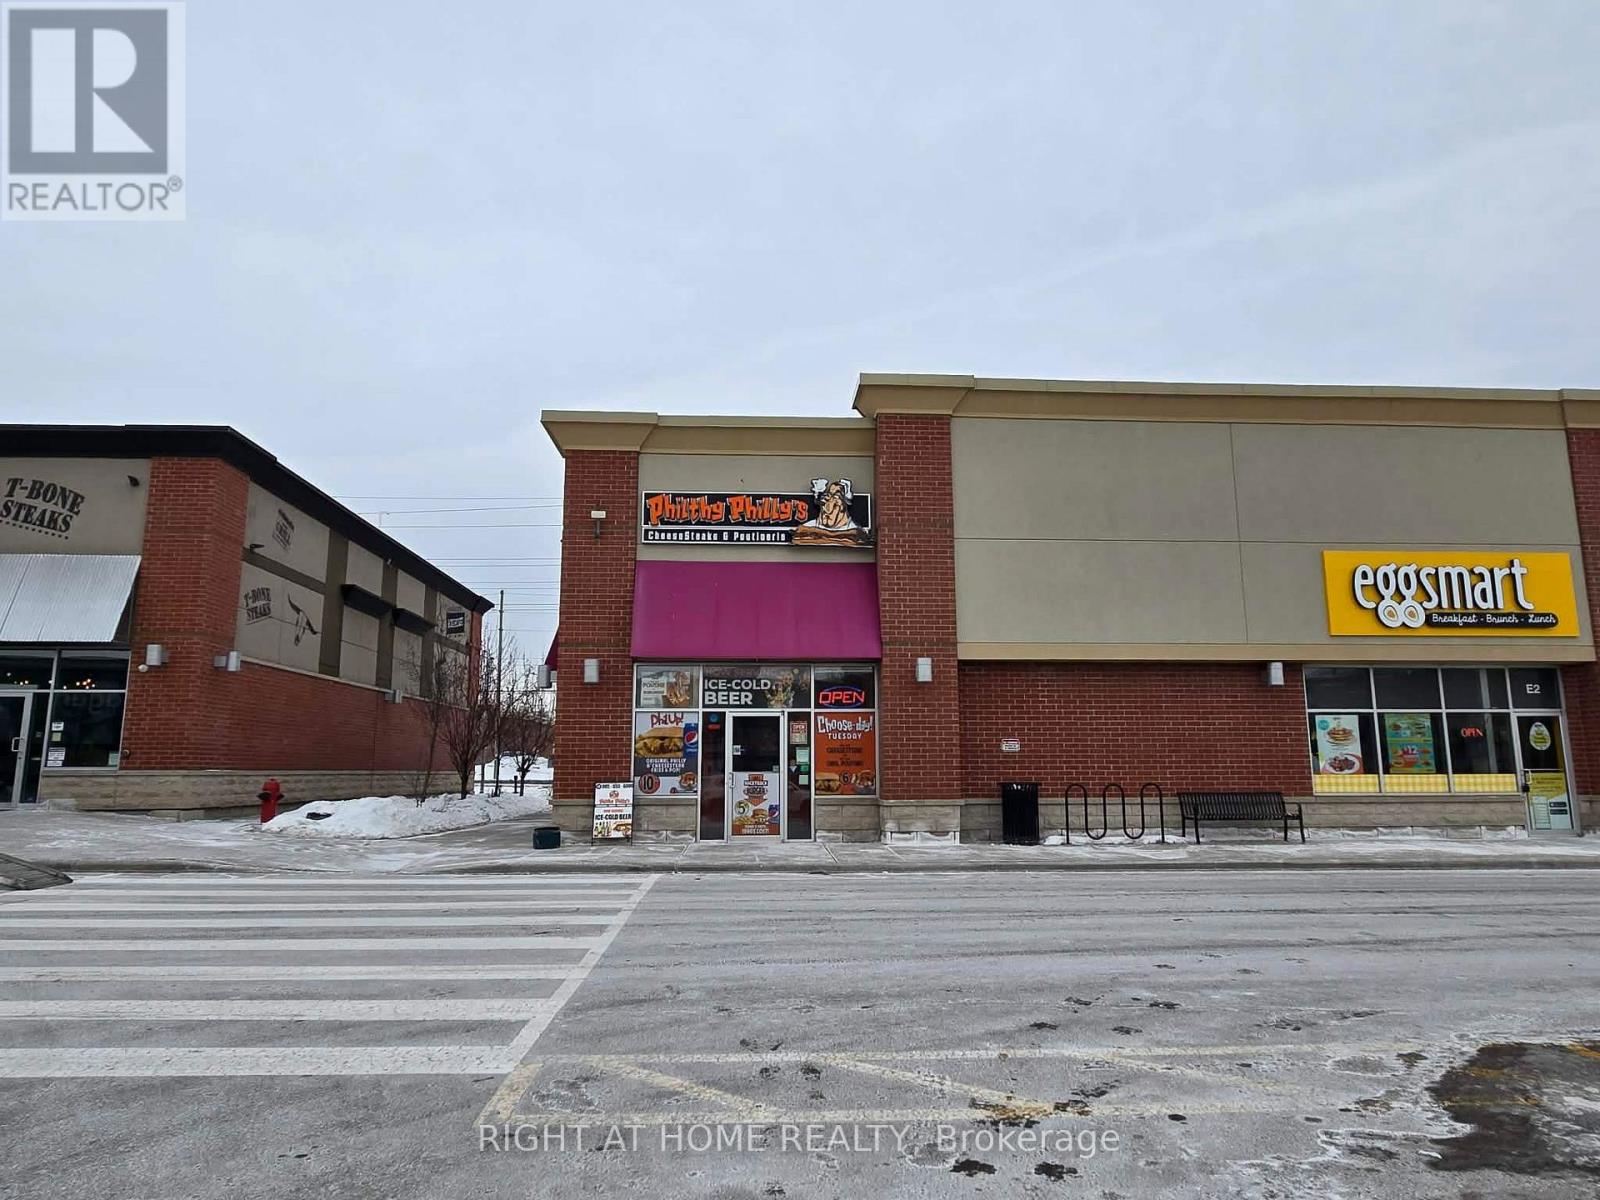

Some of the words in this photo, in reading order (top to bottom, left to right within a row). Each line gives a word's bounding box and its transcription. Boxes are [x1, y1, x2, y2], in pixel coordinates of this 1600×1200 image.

[4, 477, 85, 516] T-BONE
[0, 499, 73, 533] STEAKS
[647, 493, 725, 526] Philthy
[727, 494, 809, 523] Philly's
[734, 532, 785, 542] Poutinerie
[244, 587, 272, 608] T-BONE
[1354, 558, 1535, 628] eggsmart
[1432, 613, 1478, 626] Breakfast
[1486, 614, 1519, 624] Brunch
[1528, 614, 1556, 624] Lunch
[704, 679, 771, 690] ICE-COLD
[1525, 684, 1541, 694] E2
[704, 692, 753, 705] BEER
[819, 690, 865, 704] OPEN
[1461, 728, 1483, 737] OPEN
